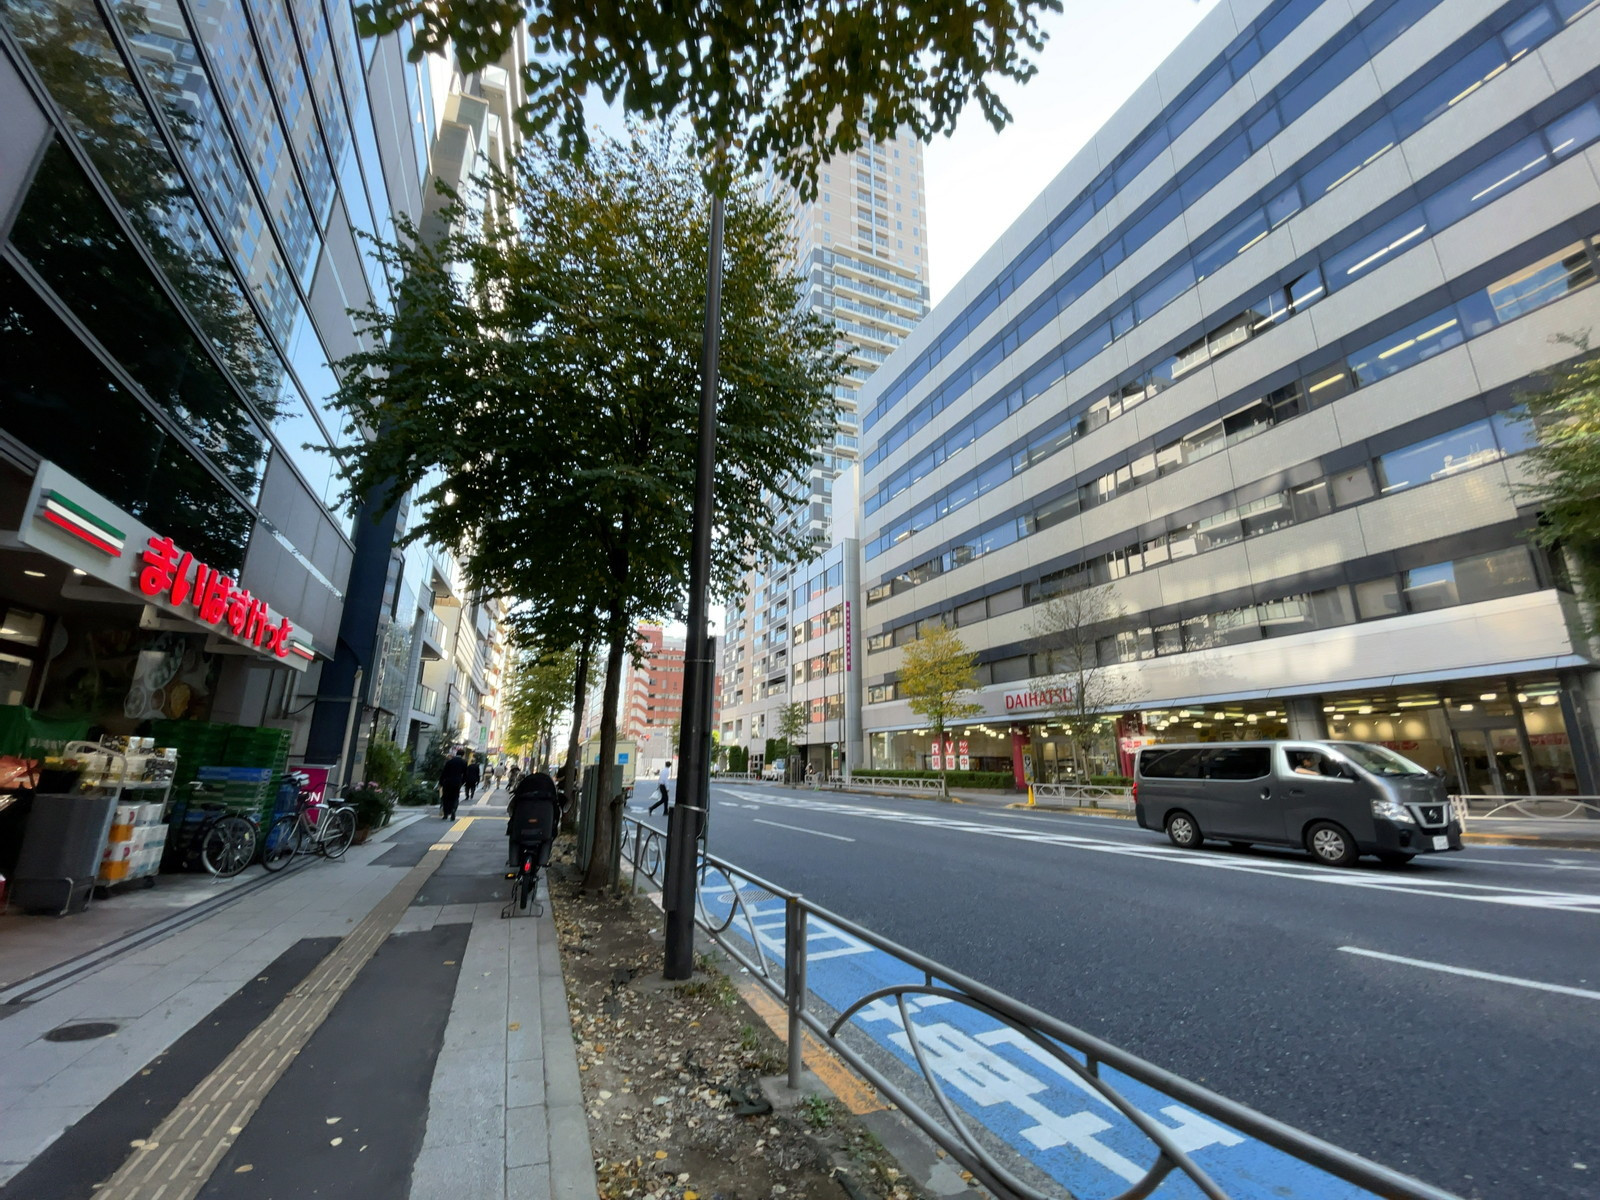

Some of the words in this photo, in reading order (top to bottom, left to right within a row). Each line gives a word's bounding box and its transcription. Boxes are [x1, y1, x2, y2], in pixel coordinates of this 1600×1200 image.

[140, 537, 293, 657] まいばすけっと
[1005, 688, 1073, 710] DAIHATSU
